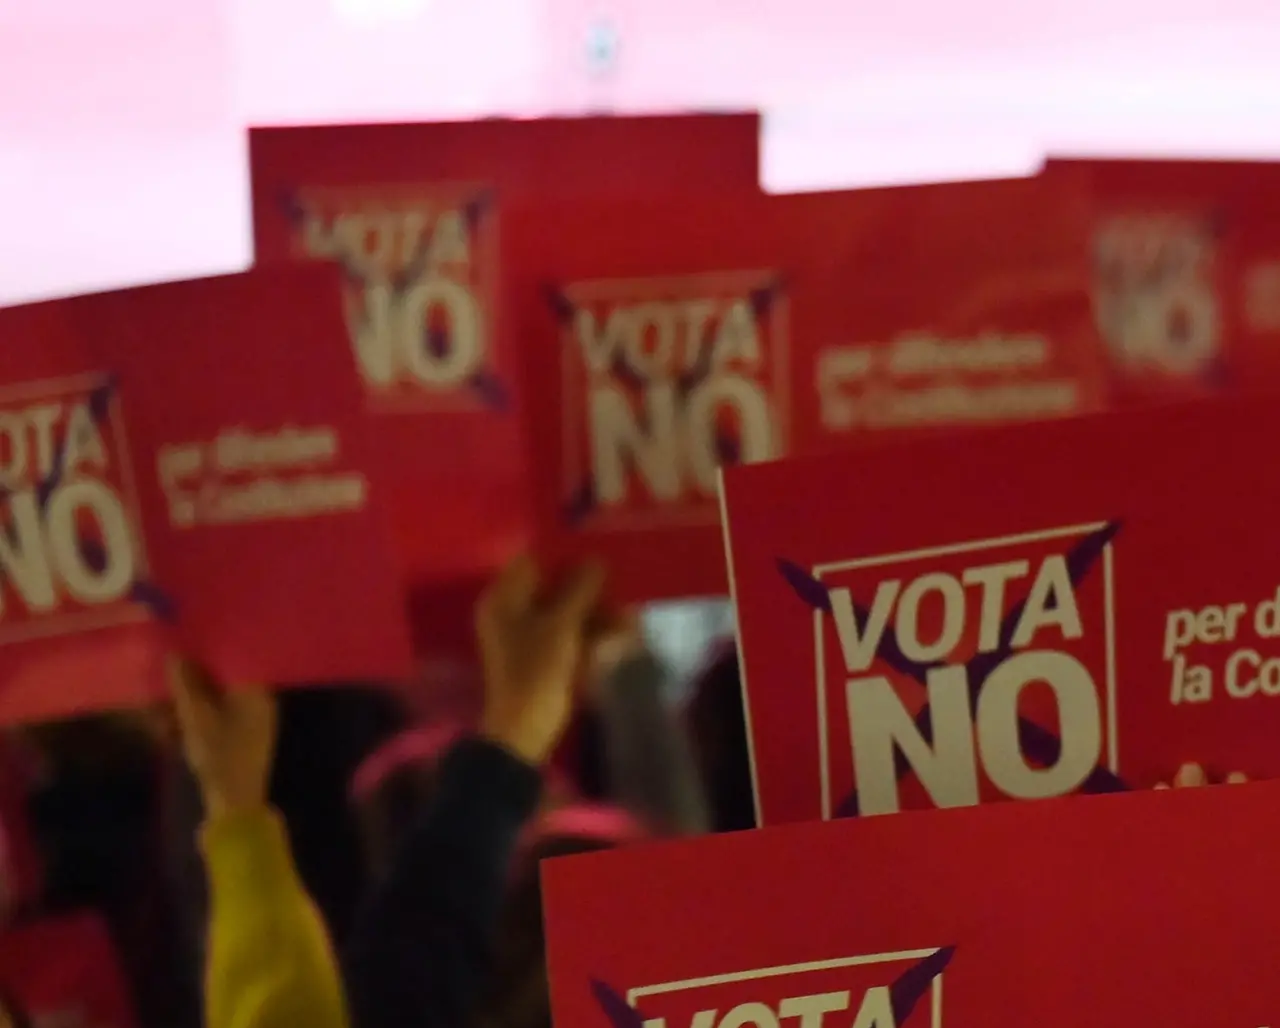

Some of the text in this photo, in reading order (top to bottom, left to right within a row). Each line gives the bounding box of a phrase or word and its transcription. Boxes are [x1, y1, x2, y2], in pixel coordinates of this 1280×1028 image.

[576, 296, 762, 382] VOTA
[0, 402, 108, 492] OTA
[588, 374, 784, 504] NO
[830, 553, 1083, 672] VOTA
[1163, 598, 1246, 660] per
[1169, 651, 1212, 705] la
[845, 649, 1101, 817] NO
